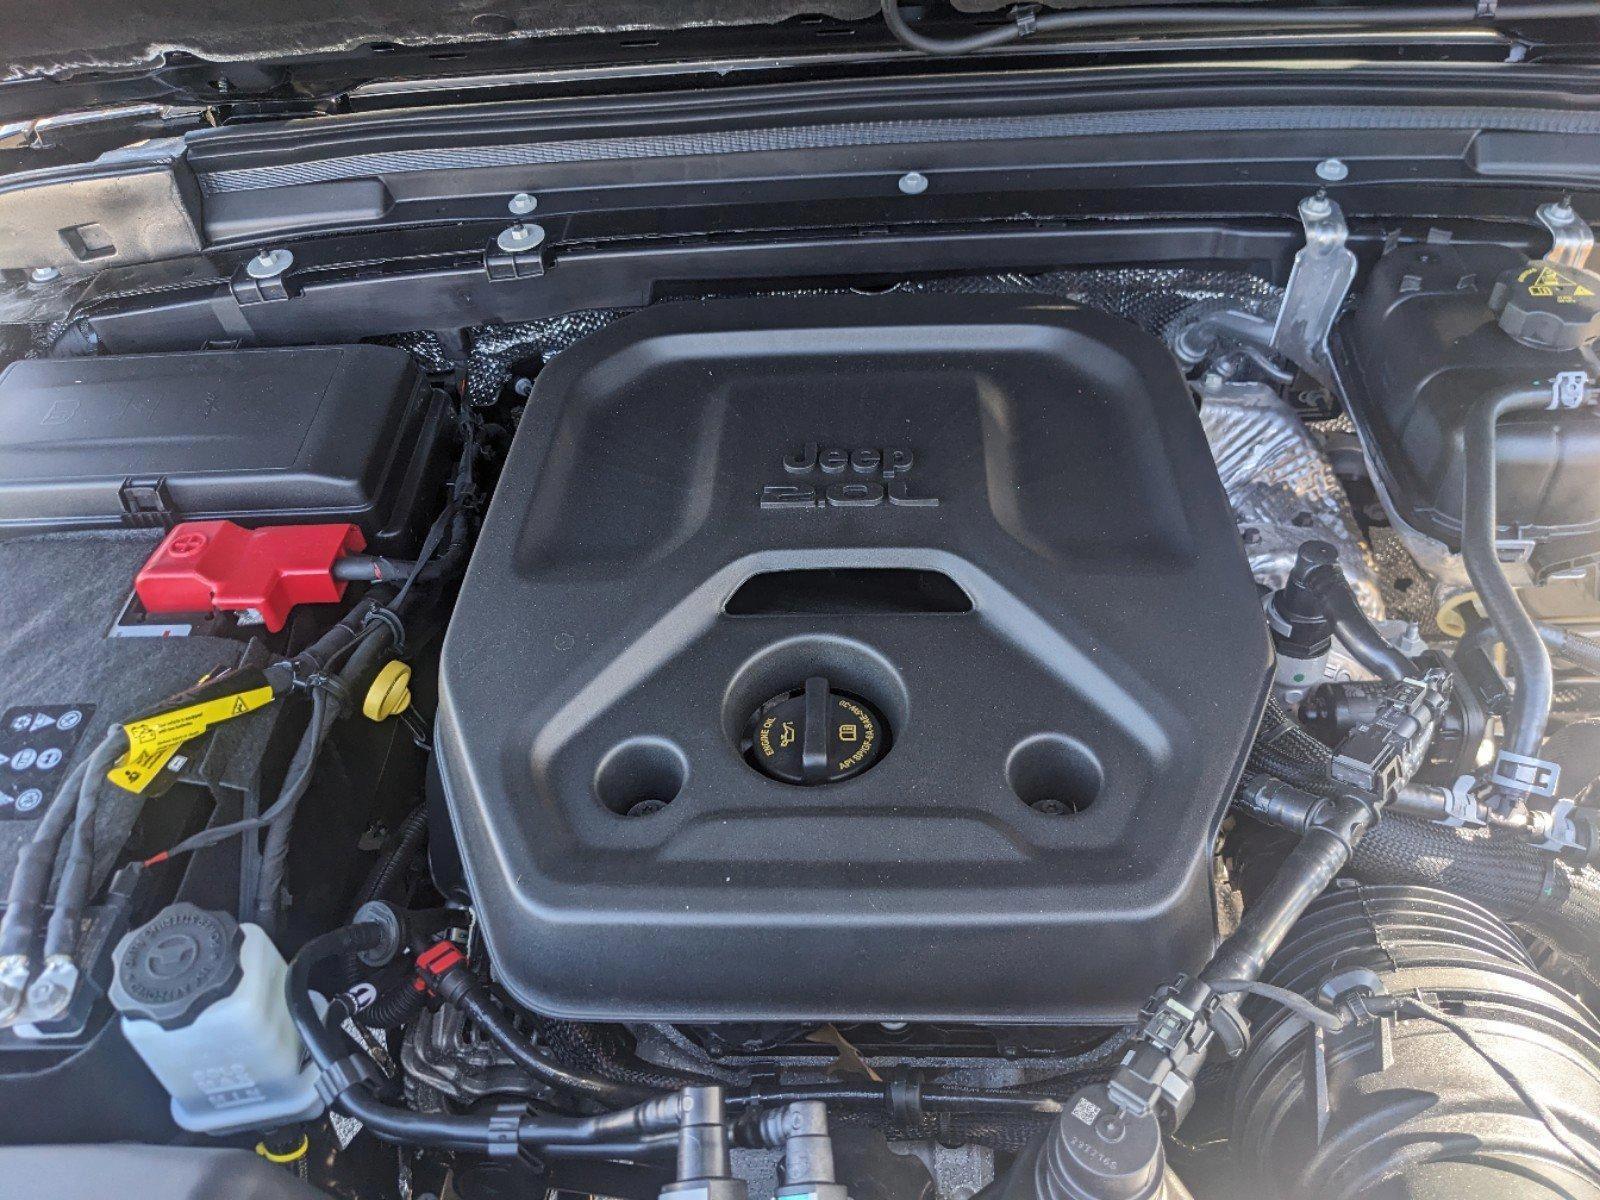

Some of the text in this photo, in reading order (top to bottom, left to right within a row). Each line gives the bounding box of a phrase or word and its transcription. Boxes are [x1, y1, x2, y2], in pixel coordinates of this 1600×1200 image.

[782, 442, 914, 478] Jeep
[760, 482, 940, 508] 2.0L
[760, 716, 776, 757] ENGINE OIL
[208, 1088, 261, 1104] MIN
